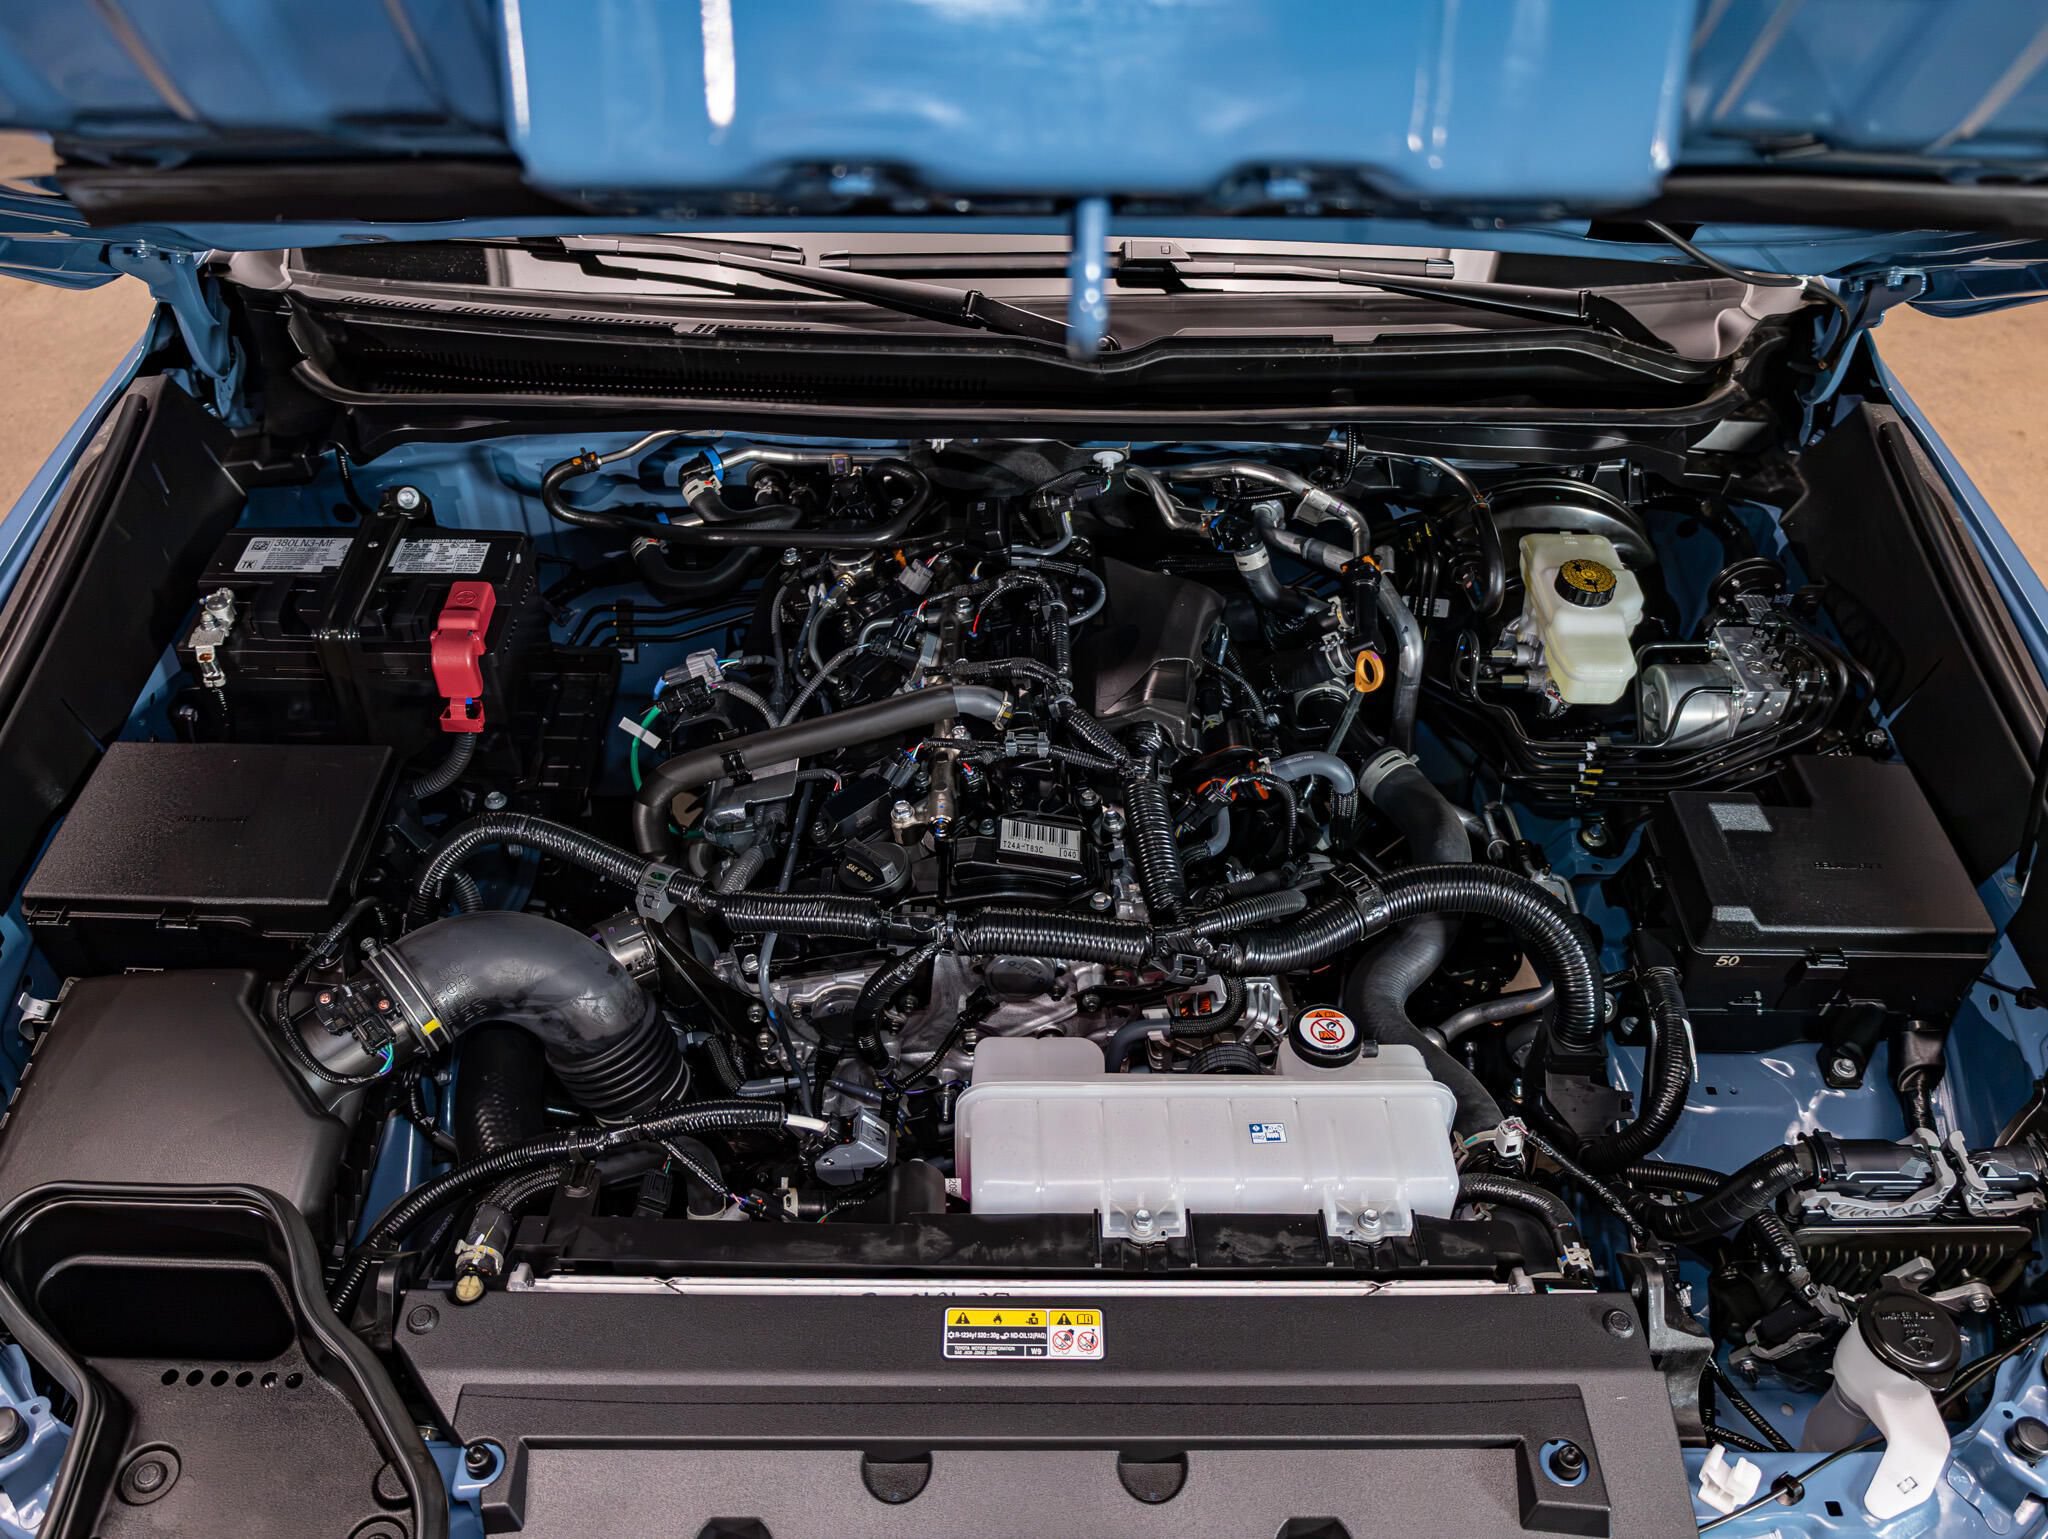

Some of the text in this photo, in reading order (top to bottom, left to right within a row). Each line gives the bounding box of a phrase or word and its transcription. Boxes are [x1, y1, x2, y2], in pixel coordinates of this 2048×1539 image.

[274, 539, 337, 547] 380LN3-MF
[1063, 851, 1077, 859] 040
[1715, 955, 1740, 966] 50
